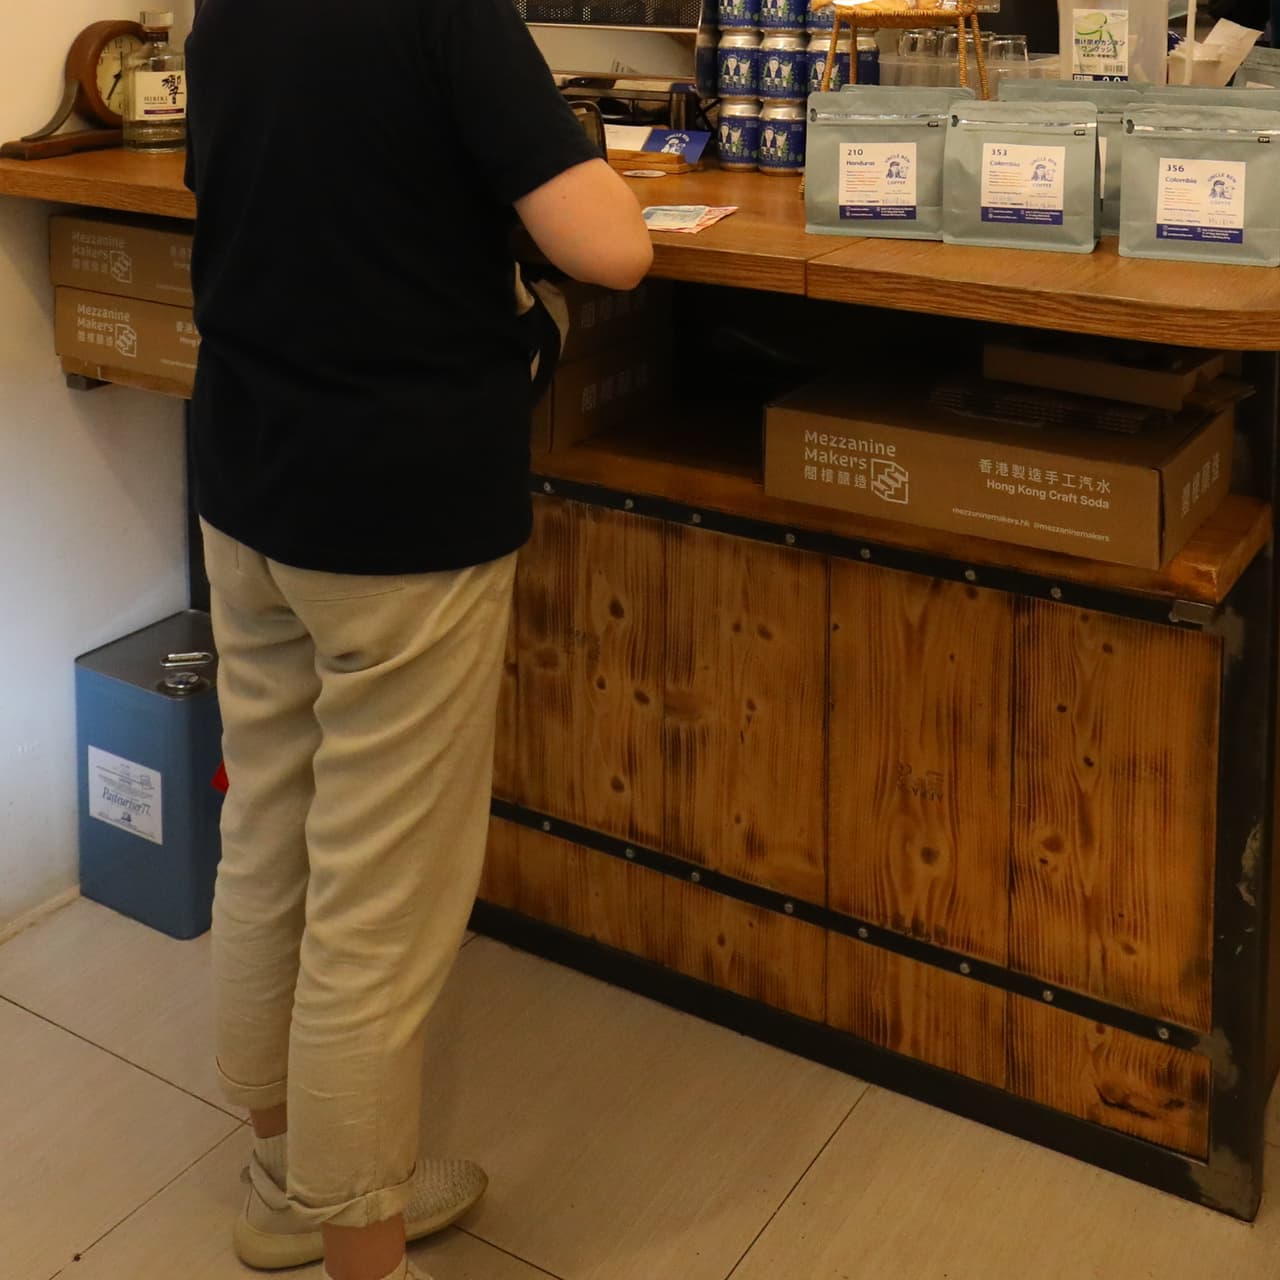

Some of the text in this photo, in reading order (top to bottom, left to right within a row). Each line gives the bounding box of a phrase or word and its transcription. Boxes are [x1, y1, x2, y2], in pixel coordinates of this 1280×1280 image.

[847, 148, 864, 156] 210
[1166, 164, 1185, 173] 356
[76, 303, 131, 322] Mezzanine
[76, 317, 114, 333] Makers
[804, 429, 897, 457] Mezzanine
[804, 447, 868, 470] Makers
[978, 458, 1111, 495] 香港製造手工汽水
[986, 477, 1110, 510] Hong Kong Craft Soda
